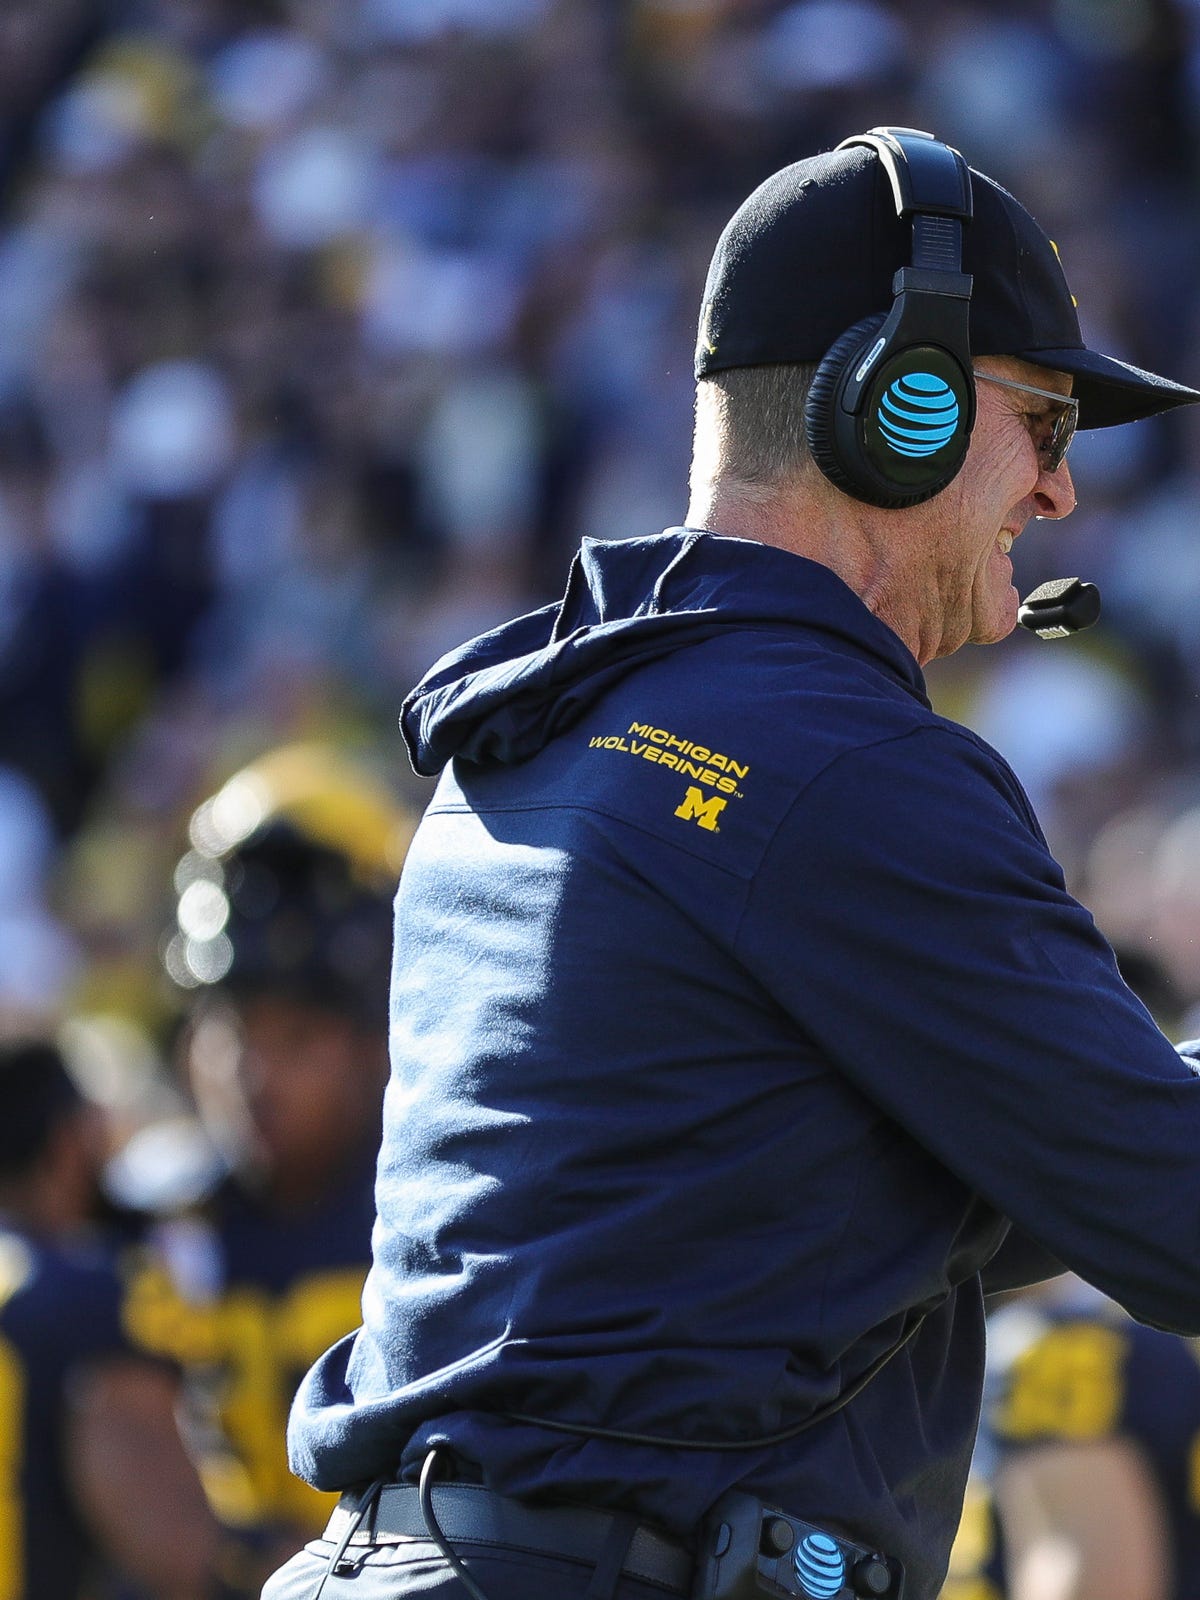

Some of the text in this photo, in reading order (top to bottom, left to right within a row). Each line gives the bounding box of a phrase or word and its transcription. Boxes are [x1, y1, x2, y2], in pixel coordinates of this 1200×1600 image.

[588, 736, 738, 794] WOLVERINES
[627, 721, 750, 779] MICHIGAN
[674, 786, 728, 832] M
